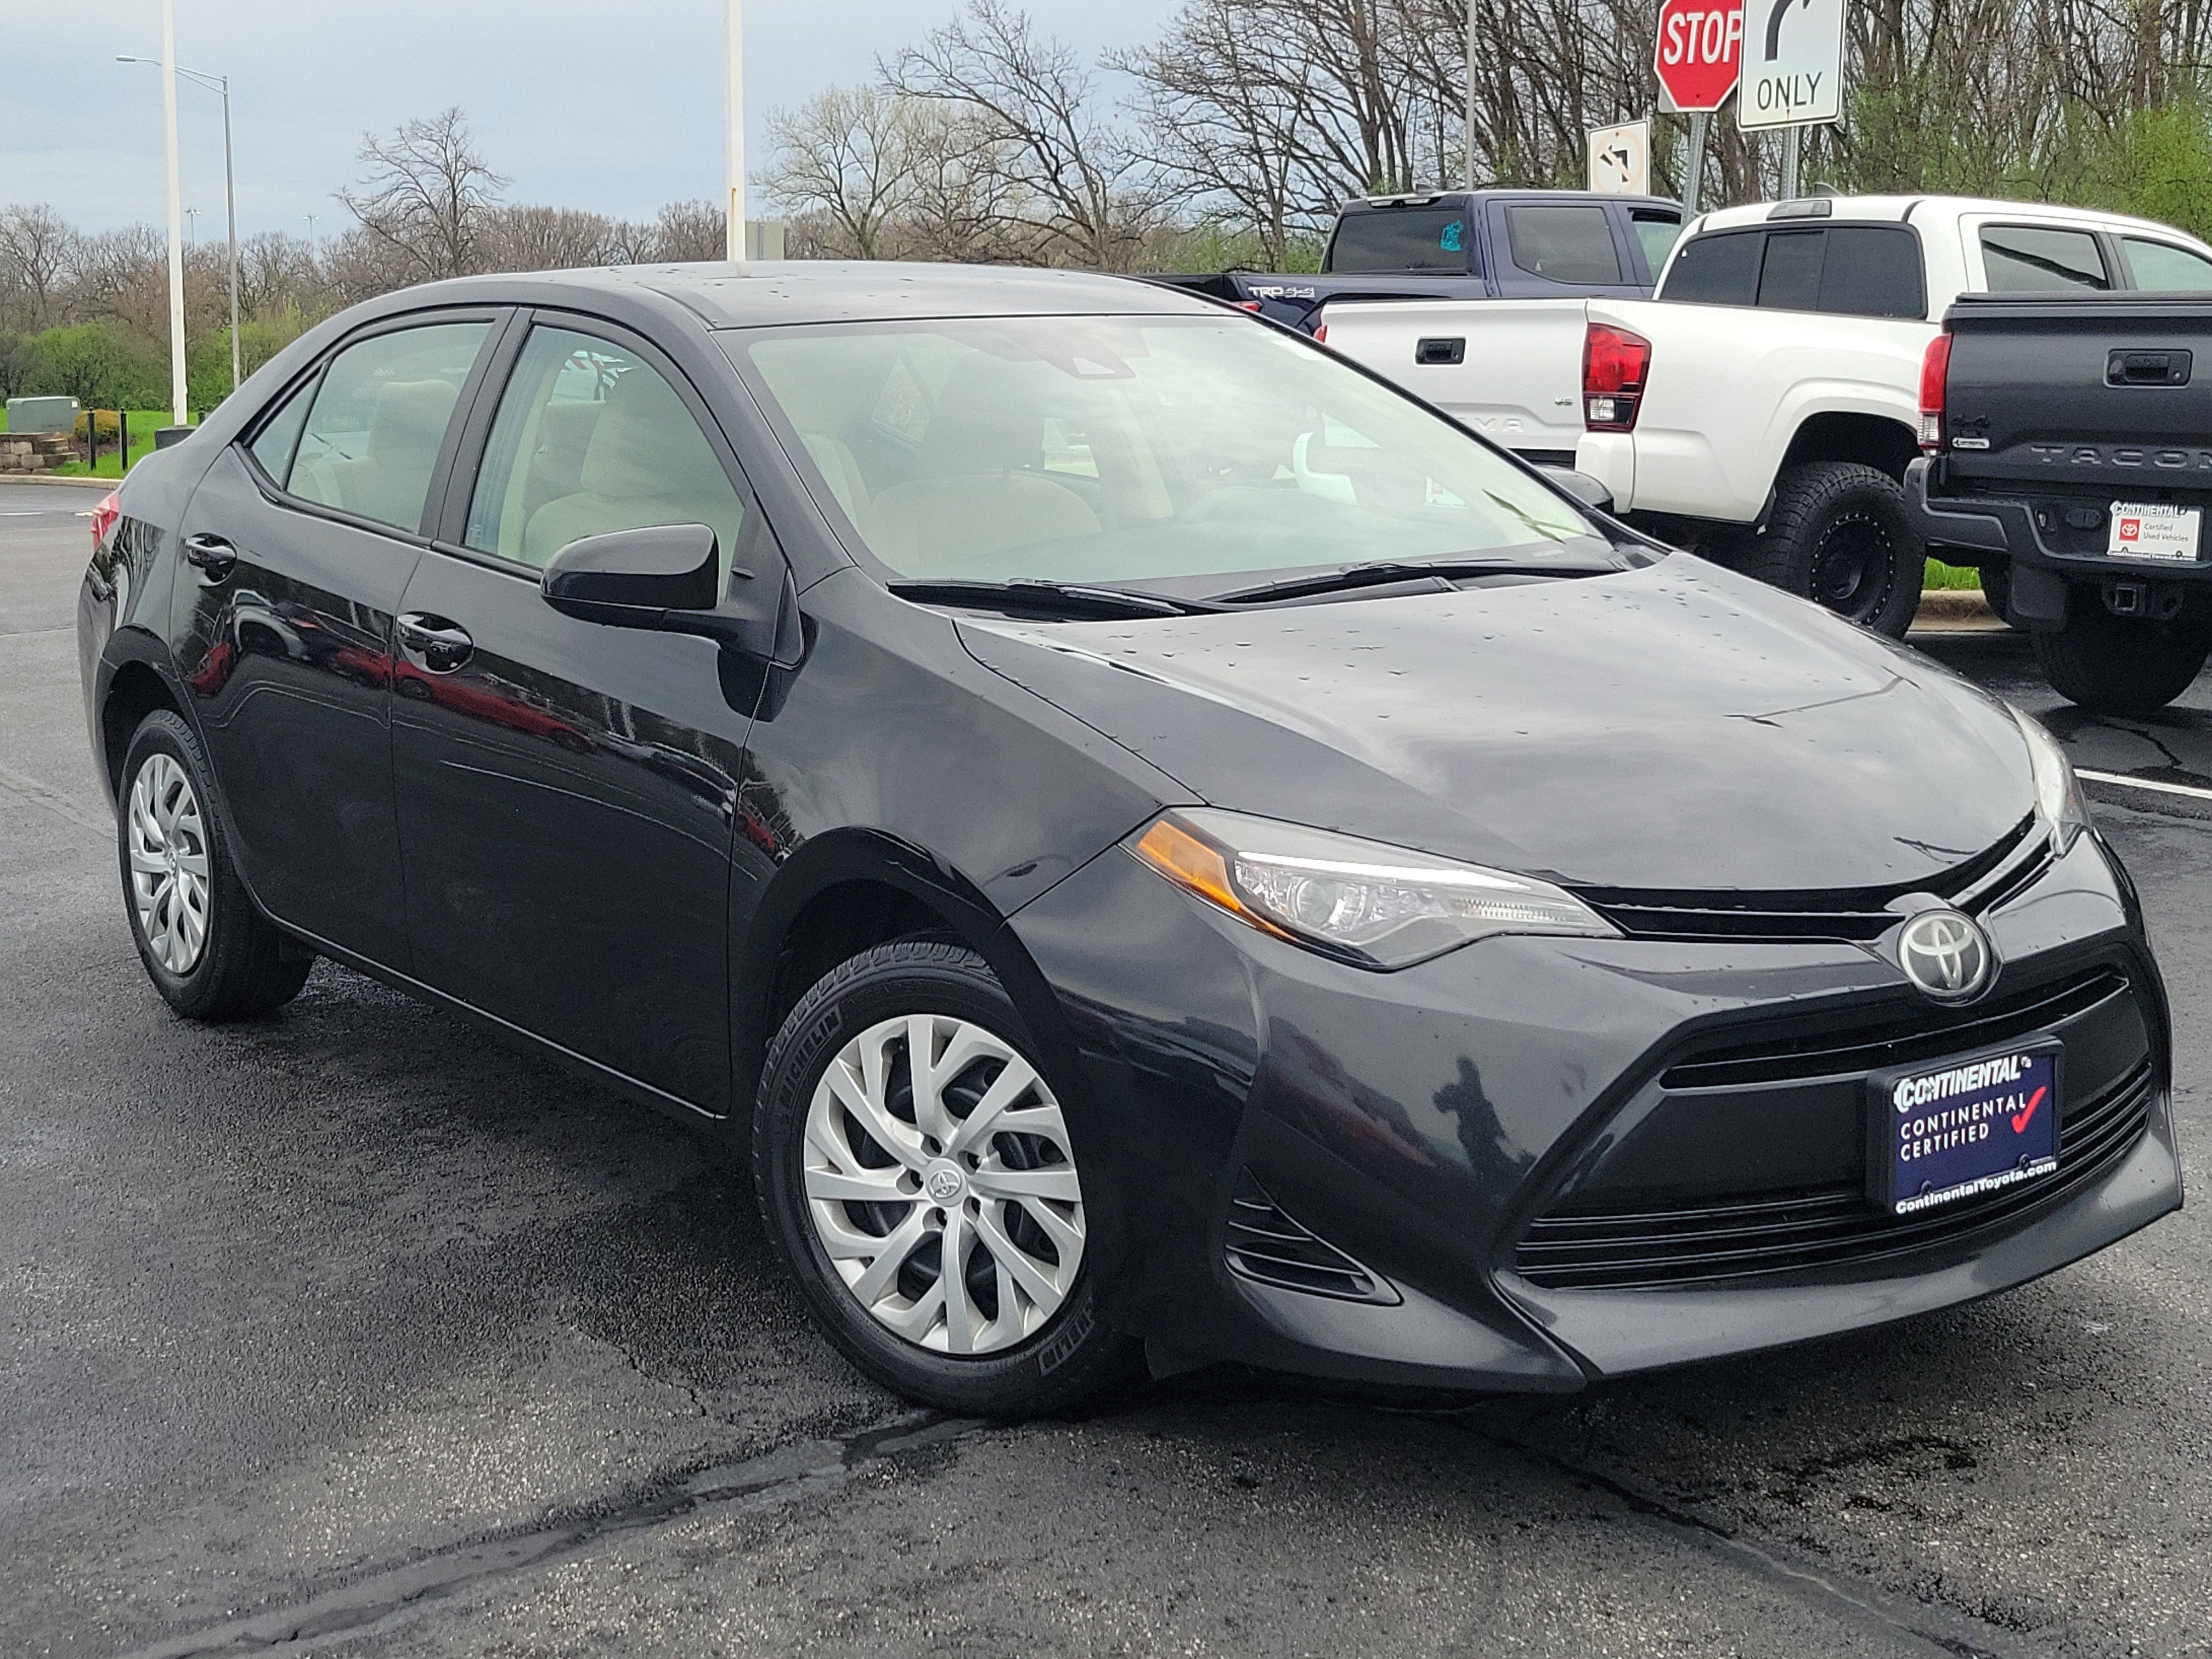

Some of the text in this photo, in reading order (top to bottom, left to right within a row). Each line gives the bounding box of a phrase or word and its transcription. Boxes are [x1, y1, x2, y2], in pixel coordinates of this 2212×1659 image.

[1663, 10, 1742, 65] STOP
[1757, 71, 1822, 110] ONLY
[1248, 286, 1284, 299] TRD
[2109, 500, 2181, 518] CONTINENTAL
[2144, 523, 2174, 532] Certified
[2143, 532, 2188, 542] Used Vehicles
[1894, 1056, 2021, 1113] CONTINENTAL
[1900, 1093, 2027, 1139] CONTINENTAL
[1900, 1123, 1989, 1161] CERTIFIED
[1895, 1161, 2057, 1215] ContinentalToyota.com
